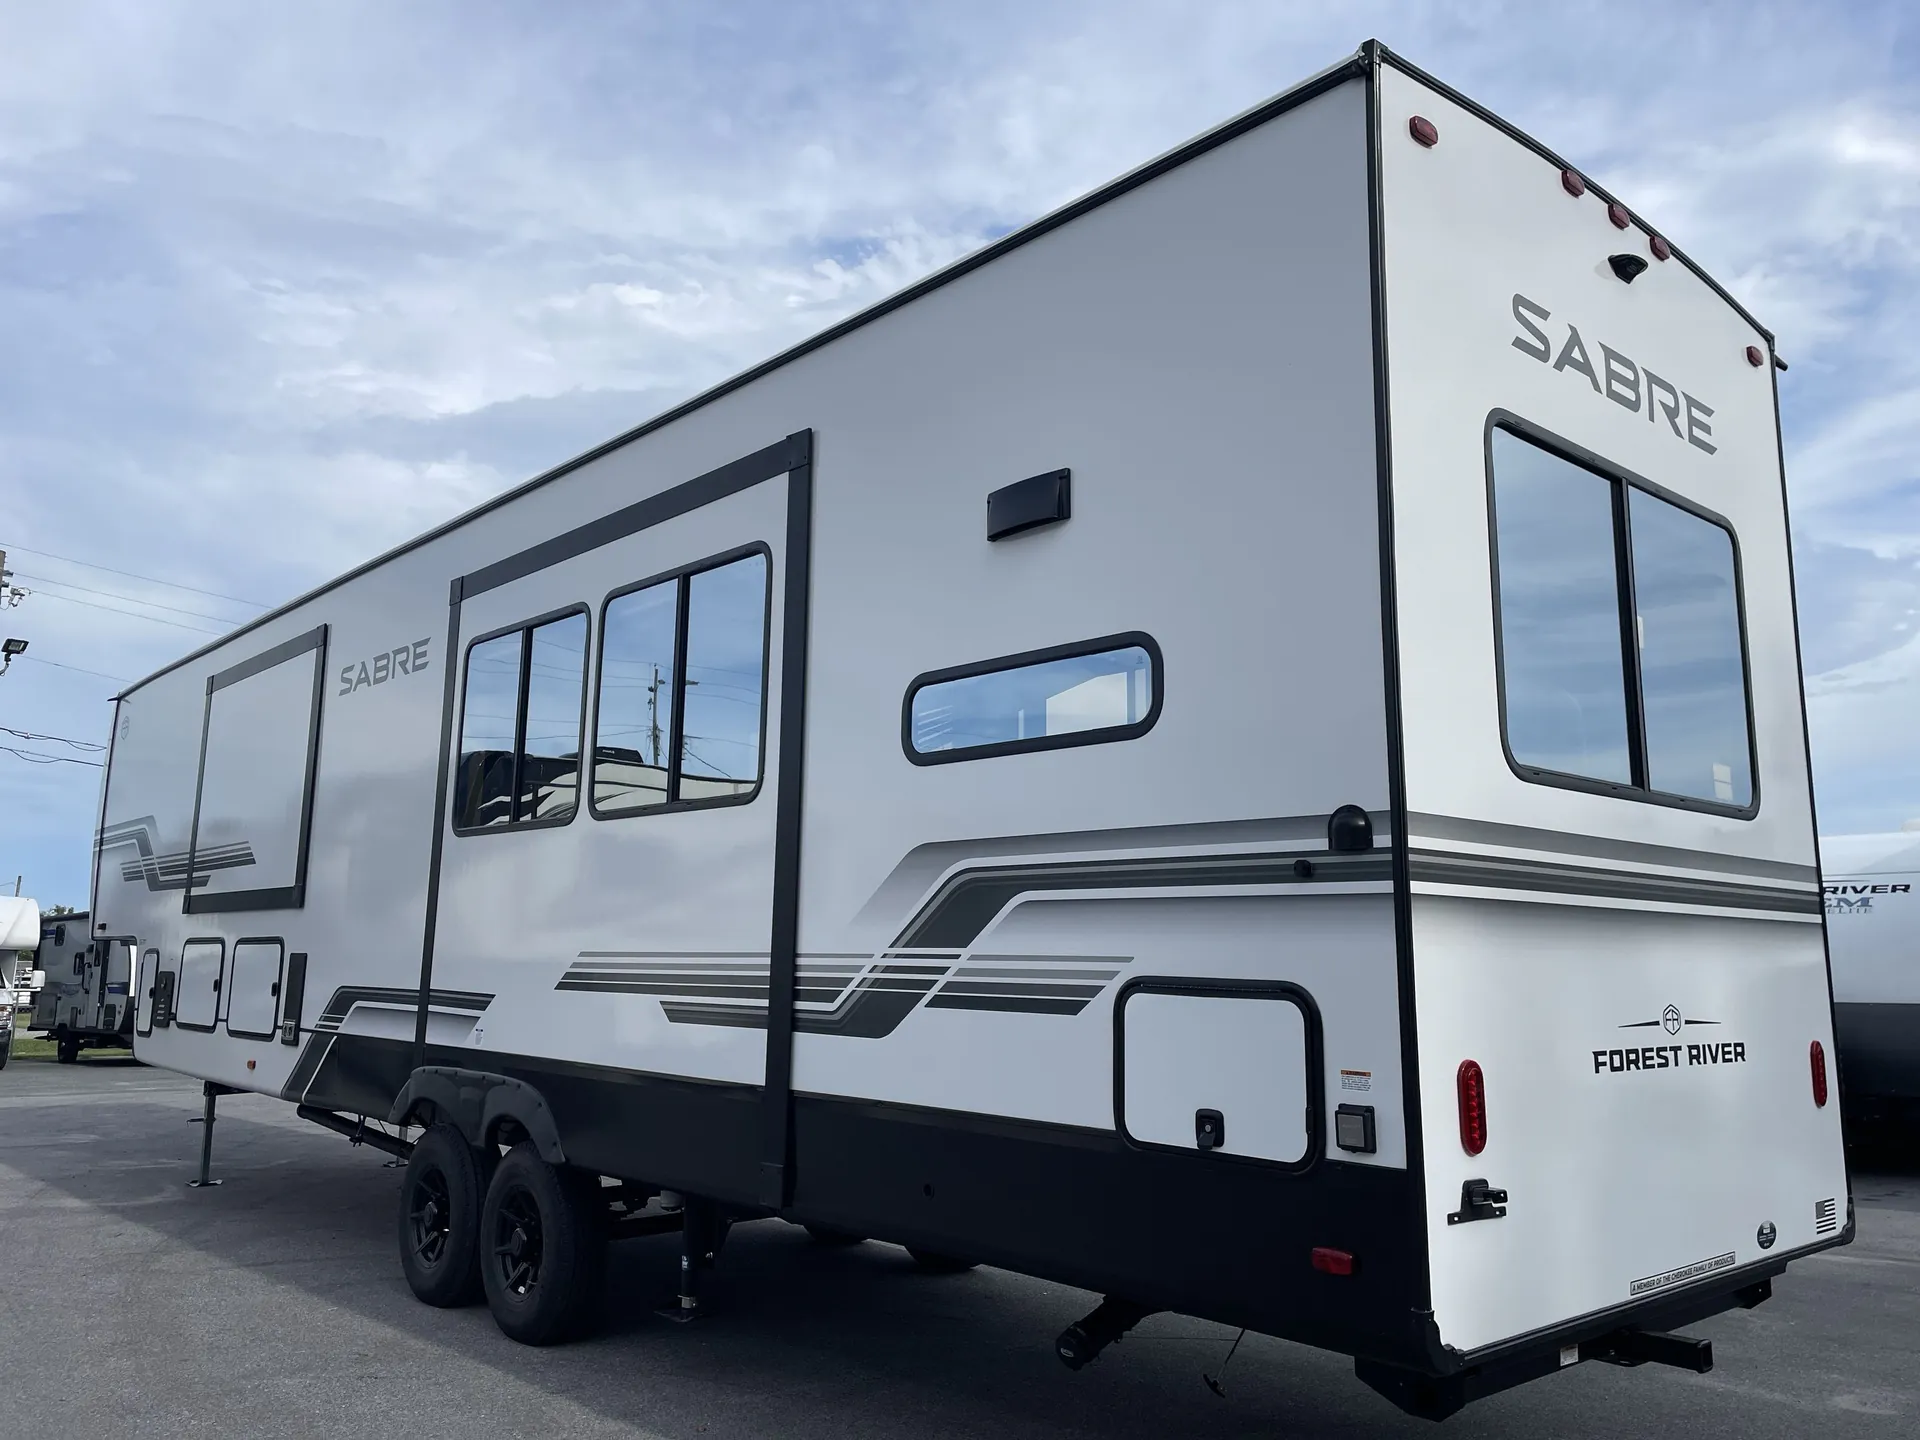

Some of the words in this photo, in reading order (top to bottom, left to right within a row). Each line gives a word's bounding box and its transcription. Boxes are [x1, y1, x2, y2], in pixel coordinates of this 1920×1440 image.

[1512, 293, 1718, 455] SABRE
[338, 637, 431, 697] SABRE
[1824, 884, 1911, 895] RIVER
[1592, 1045, 1682, 1074] FOREST
[1687, 1042, 1746, 1066] RIVER
[1636, 1280, 1655, 1290] MEMBER
[1662, 1275, 1671, 1283] THE
[1671, 1267, 1693, 1280] CHEROKEE
[1693, 1264, 1707, 1273] FAMILY
[1713, 1255, 1734, 1267] PRODUCTS
